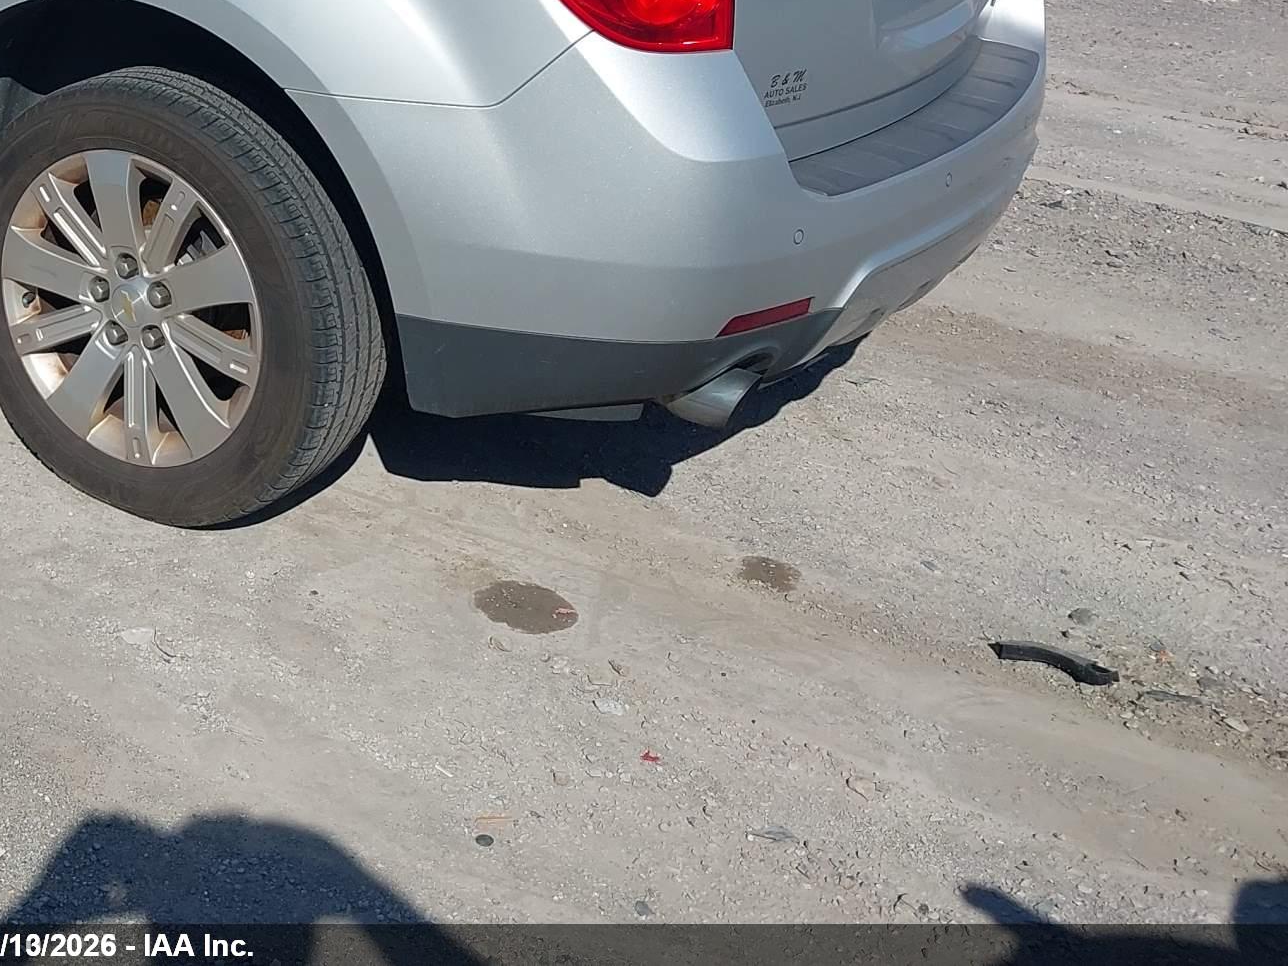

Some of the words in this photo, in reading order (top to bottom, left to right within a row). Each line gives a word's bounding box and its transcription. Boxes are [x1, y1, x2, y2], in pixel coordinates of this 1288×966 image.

[771, 75, 780, 88] B
[782, 73, 791, 85] &
[764, 89, 783, 99] AUTO
[785, 83, 807, 94] SALES
